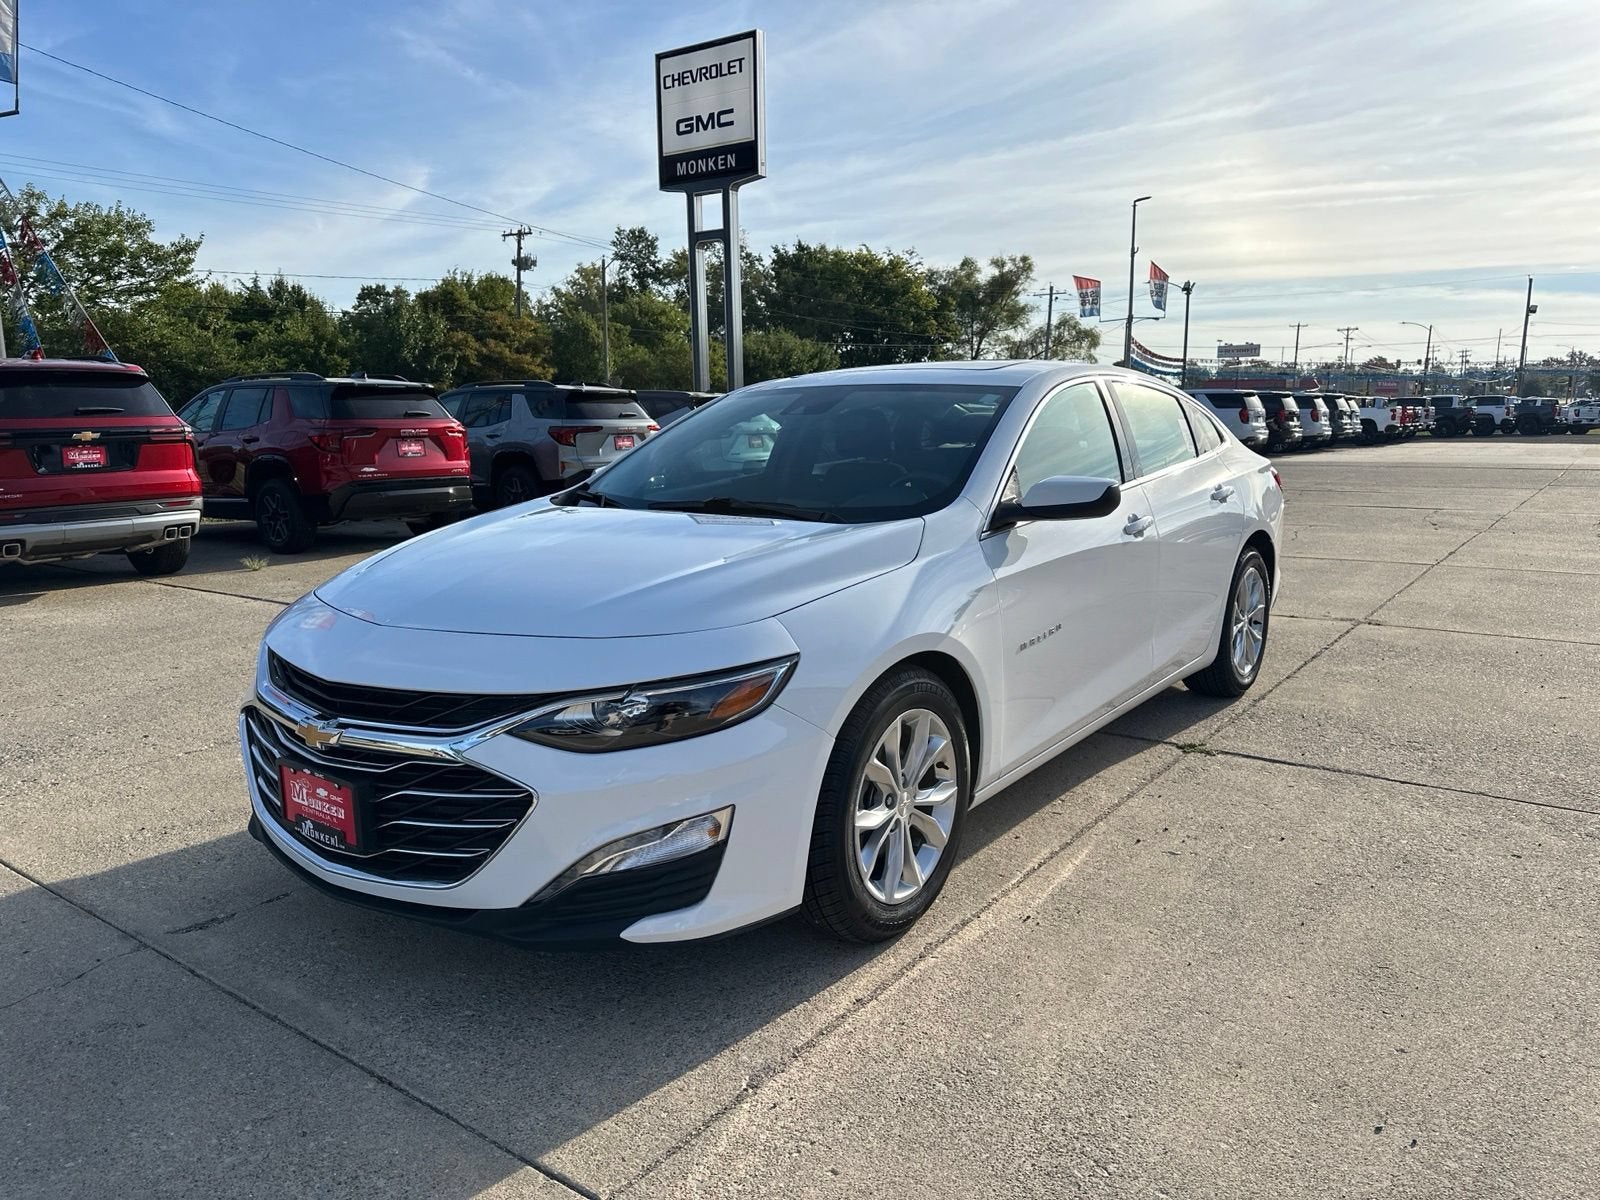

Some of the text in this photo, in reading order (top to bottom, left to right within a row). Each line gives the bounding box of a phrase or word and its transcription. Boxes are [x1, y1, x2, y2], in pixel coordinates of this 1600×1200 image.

[663, 57, 745, 90] CHEVROLET
[676, 108, 734, 136] GMC
[677, 153, 736, 176] MONKEN
